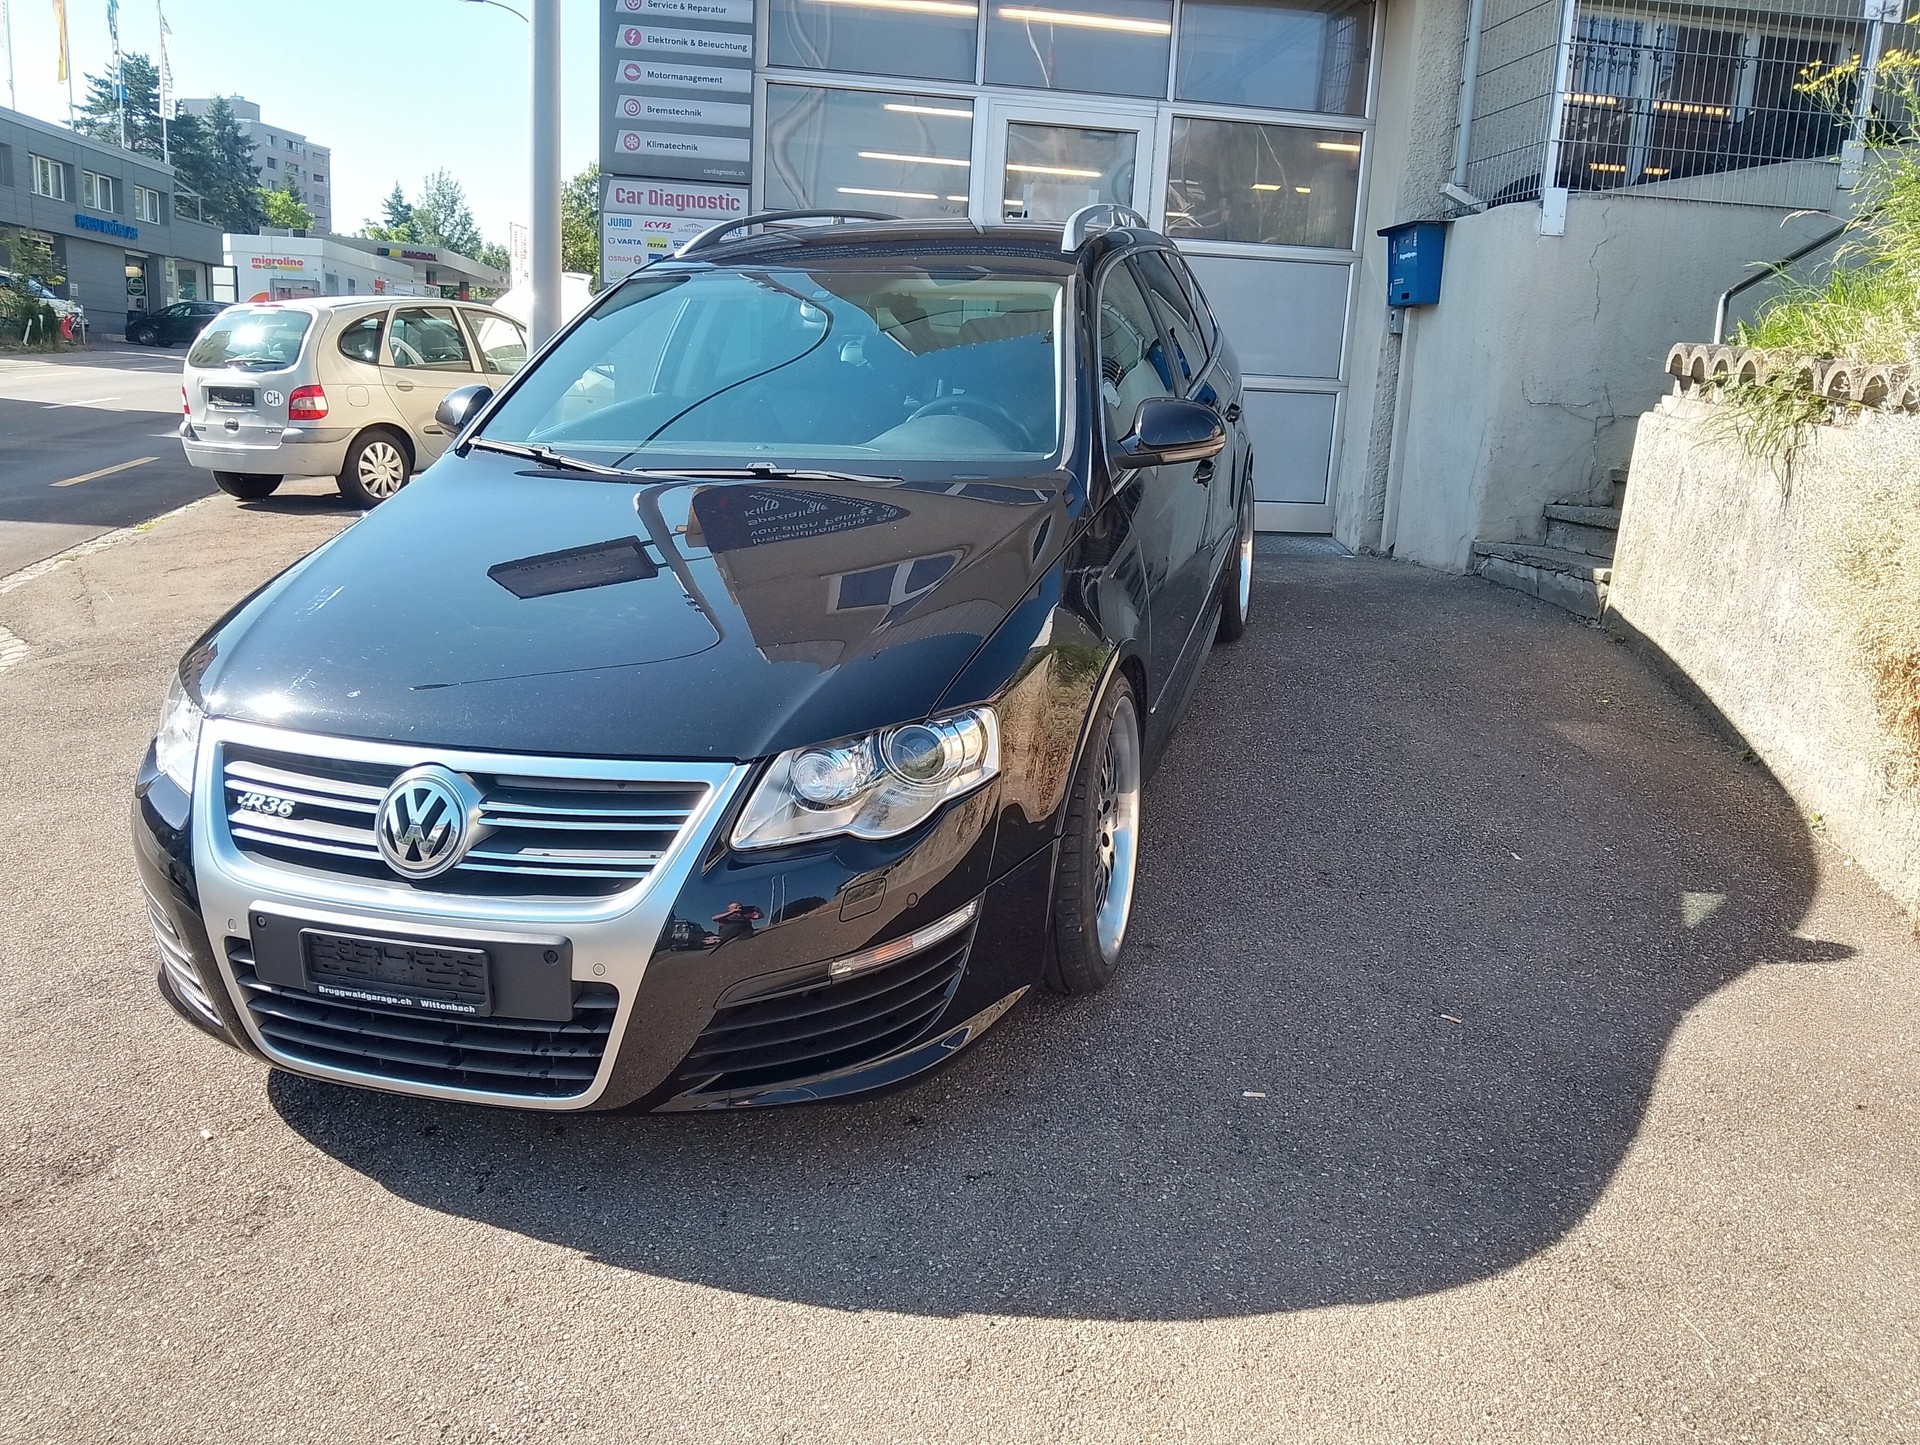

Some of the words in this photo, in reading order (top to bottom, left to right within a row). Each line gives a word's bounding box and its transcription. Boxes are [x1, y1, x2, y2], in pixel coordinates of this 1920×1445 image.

[647, 1, 677, 9] Service
[688, 4, 727, 16] Reparatur
[647, 36, 688, 46] Elektronik
[690, 39, 696, 47] &
[698, 40, 748, 52] Beleuchtung
[647, 70, 723, 84] Motormanagement
[647, 105, 702, 117] Bremstechnik
[647, 140, 699, 152] Klimatechnik
[703, 168, 746, 177] cardiagnostic.ch
[615, 187, 644, 205] Car
[648, 188, 741, 212] Diagnostic
[608, 217, 632, 228] JURID
[643, 220, 672, 230] KYB
[617, 238, 642, 246] VARTA
[251, 255, 304, 267] migrolino
[402, 250, 438, 262] MIGROL
[267, 391, 280, 404] CH
[244, 793, 295, 817] R36
[318, 985, 413, 1006] Bruggwaldgarage.ch
[420, 999, 476, 1013] Wittenbach
